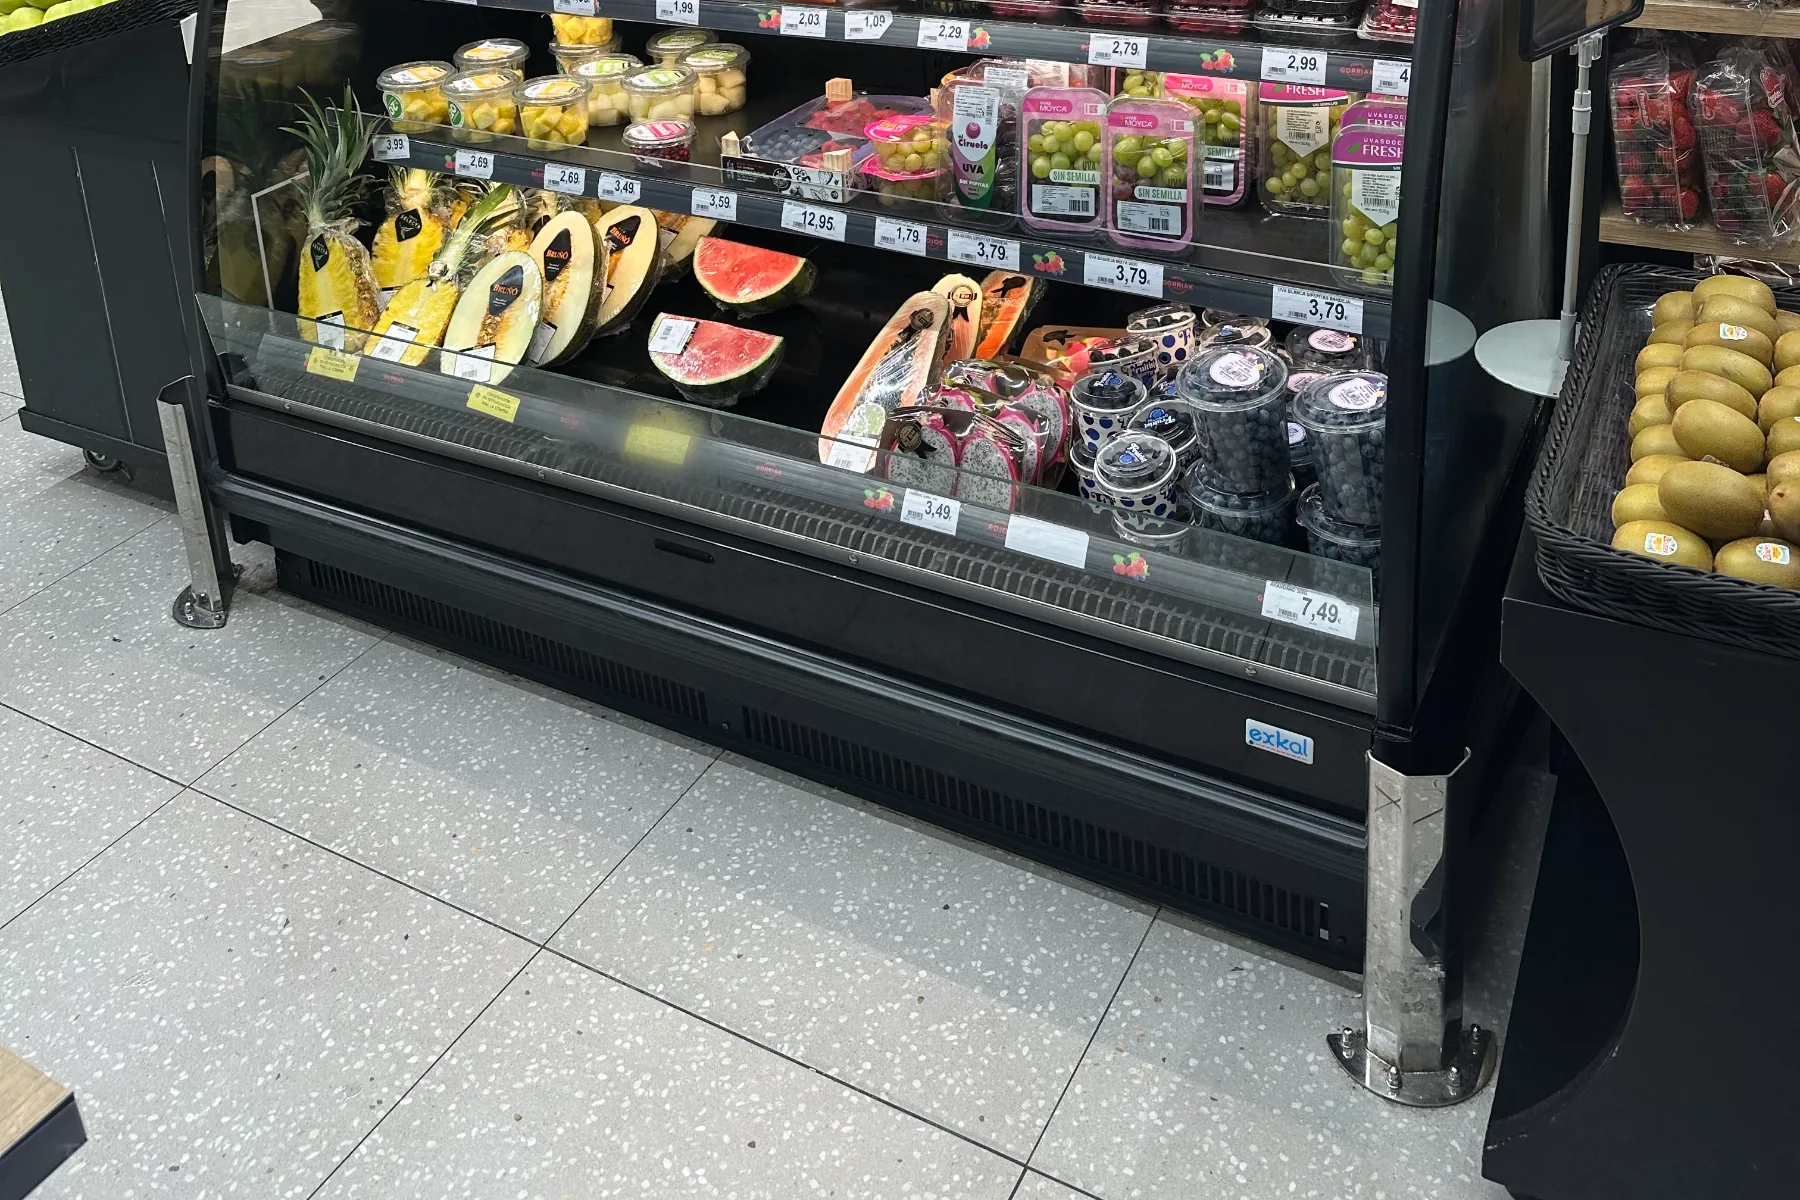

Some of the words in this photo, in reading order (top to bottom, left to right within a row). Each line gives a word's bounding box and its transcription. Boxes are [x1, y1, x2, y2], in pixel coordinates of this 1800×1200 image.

[1181, 83, 1208, 91] MOYCA
[1286, 84, 1325, 97] FRESH
[1124, 120, 1153, 128] MOYCA
[958, 139, 988, 150] Ciruelo
[962, 163, 984, 174] UVA
[1082, 160, 1096, 171] UVA
[1053, 170, 1065, 180] SIN
[1066, 171, 1096, 182] SEMILLA
[1138, 187, 1150, 198] SIN
[1152, 188, 1182, 200] SEMILLA
[1249, 728, 1308, 757] exkal
